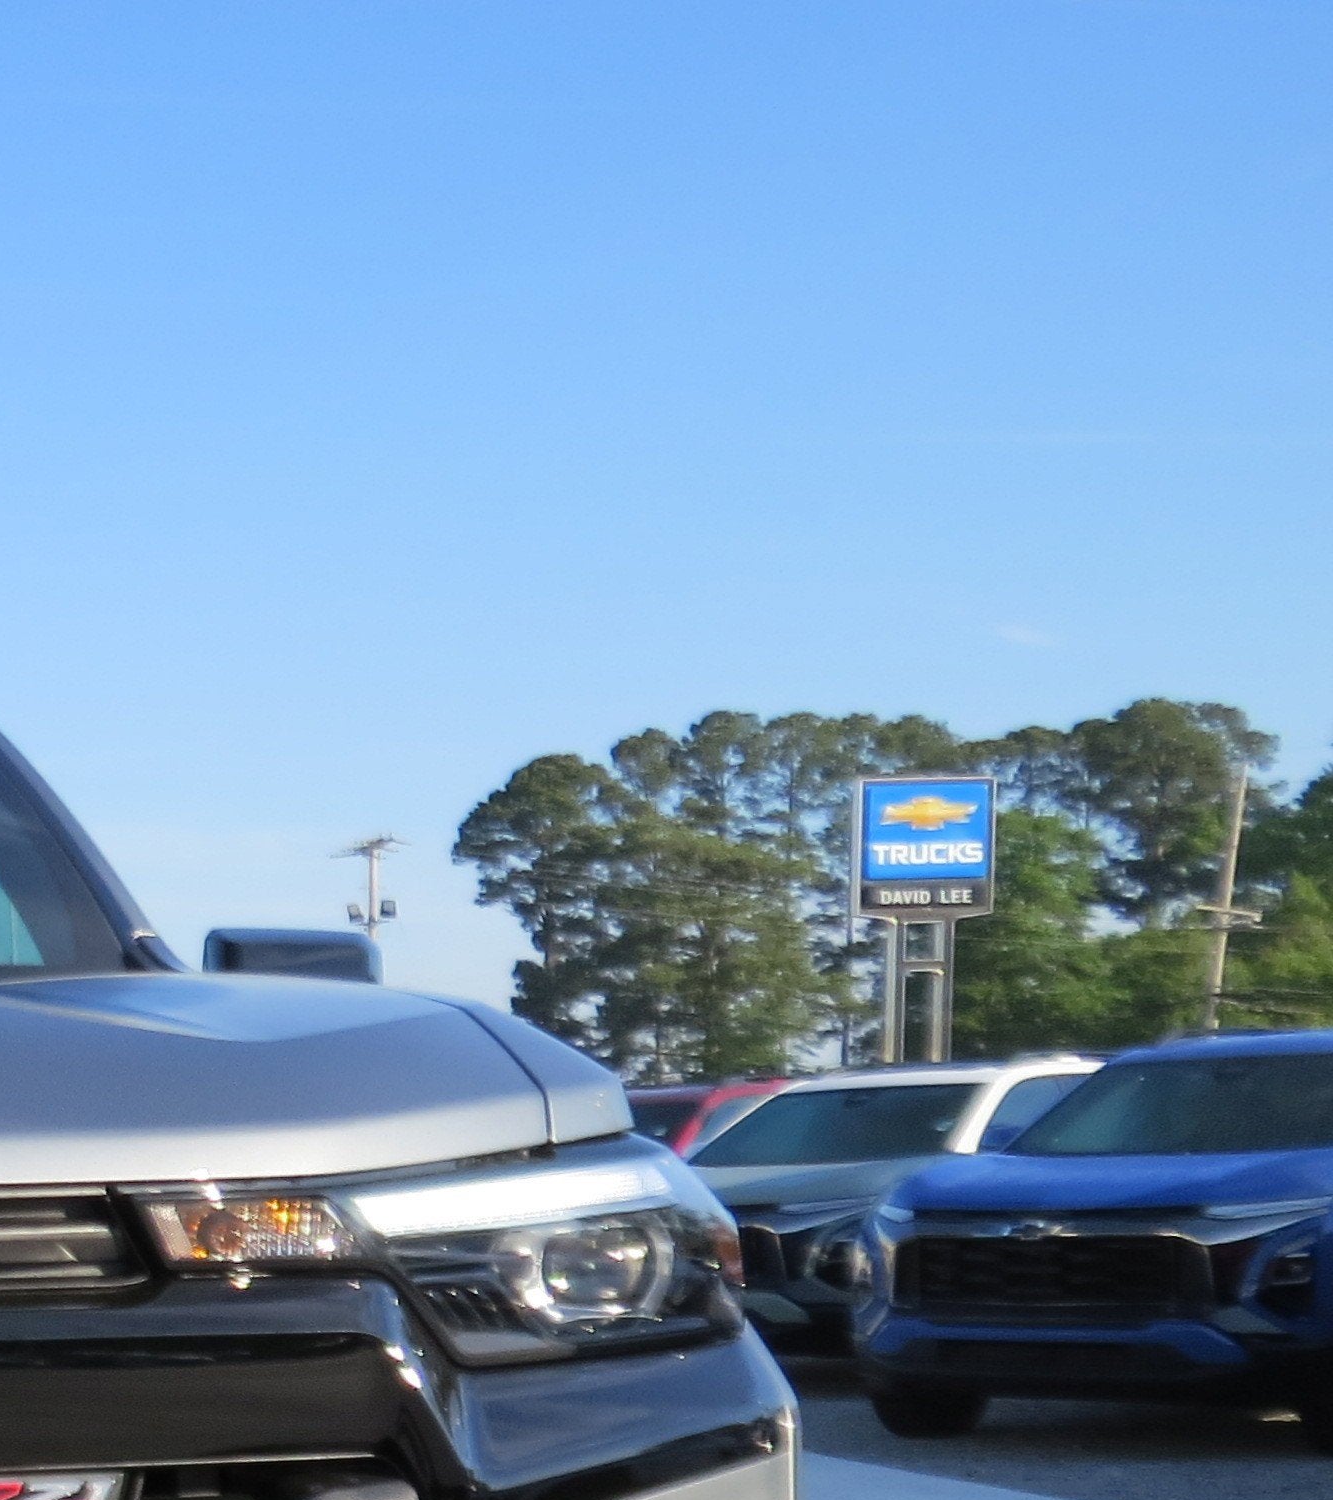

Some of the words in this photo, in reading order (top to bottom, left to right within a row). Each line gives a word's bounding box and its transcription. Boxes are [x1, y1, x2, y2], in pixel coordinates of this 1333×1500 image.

[872, 842, 984, 866] TRUCKS
[880, 888, 932, 906] DAVID
[939, 888, 974, 905] LEE
